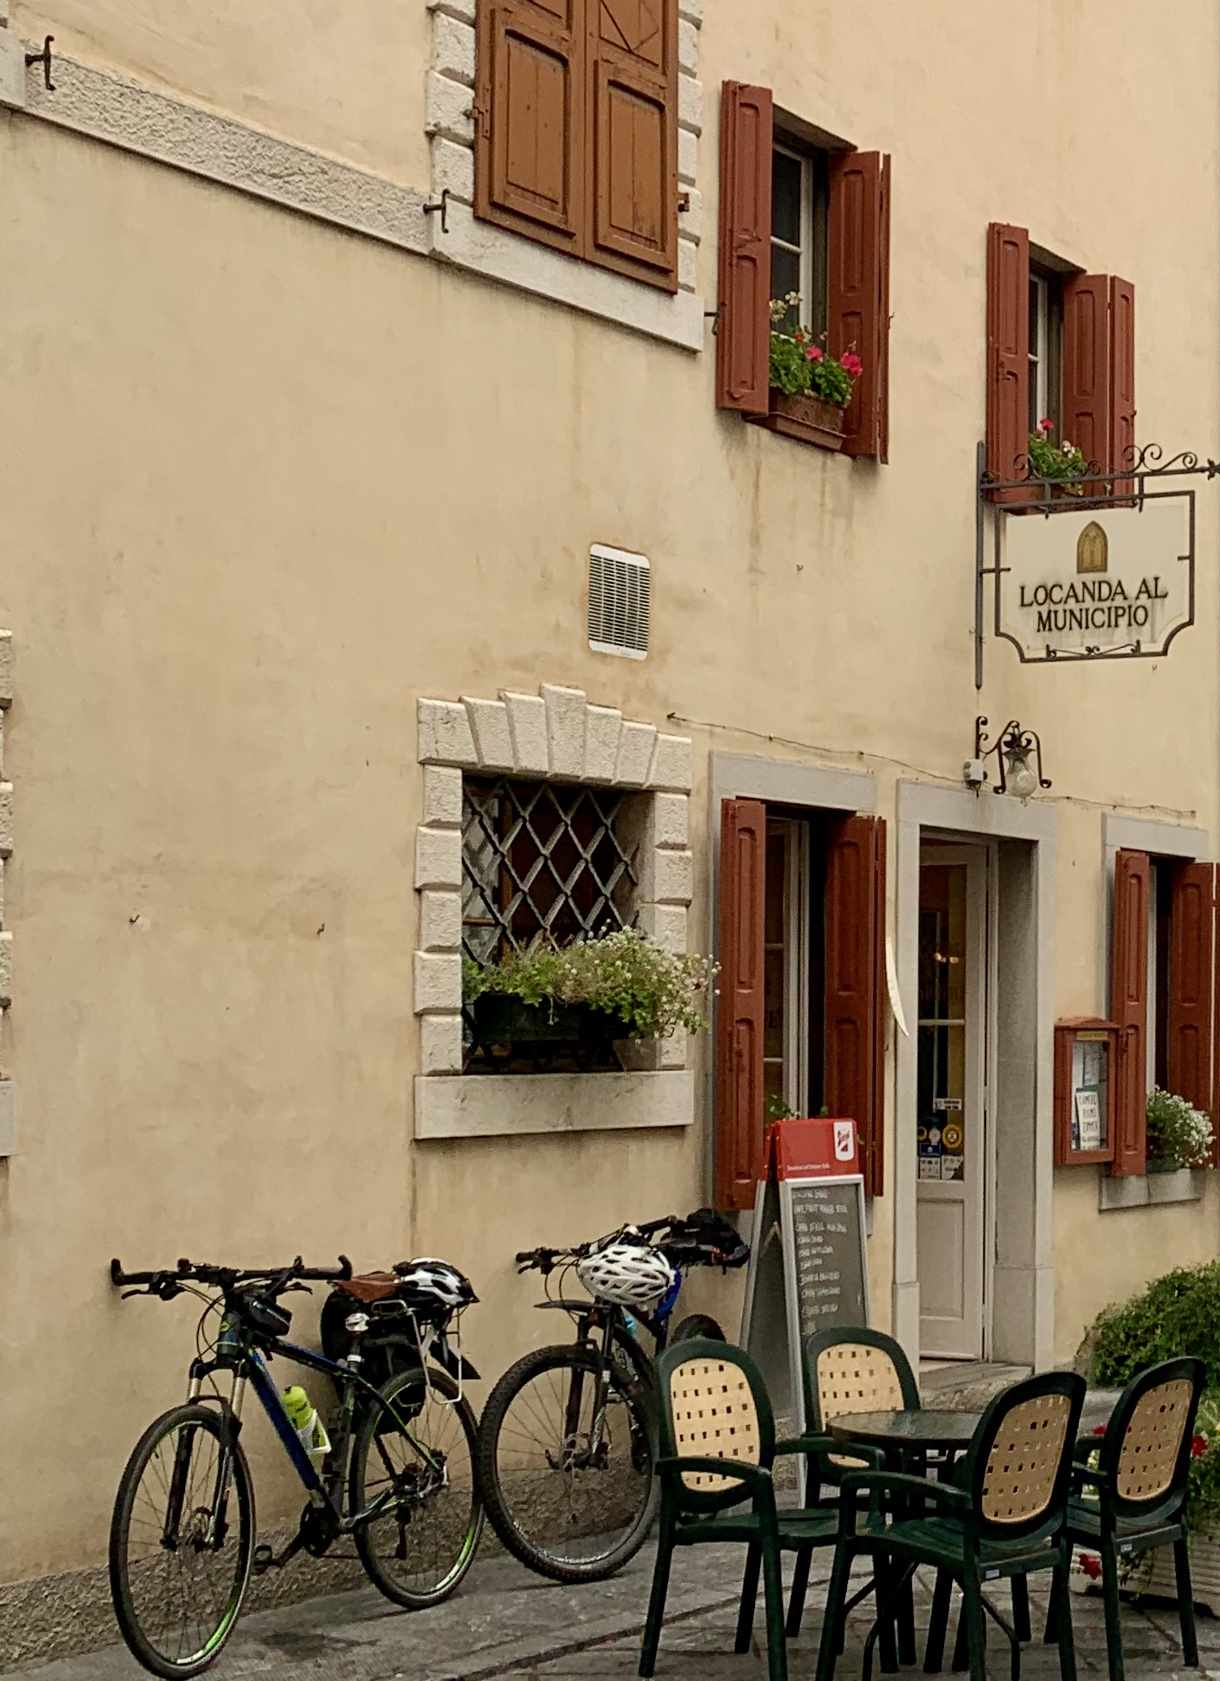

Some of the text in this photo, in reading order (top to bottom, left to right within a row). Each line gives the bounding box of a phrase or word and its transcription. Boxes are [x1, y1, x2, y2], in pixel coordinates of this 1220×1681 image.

[1019, 576, 1169, 608] LOCANDA AL
[1036, 604, 1149, 632] MUNICIPIO
